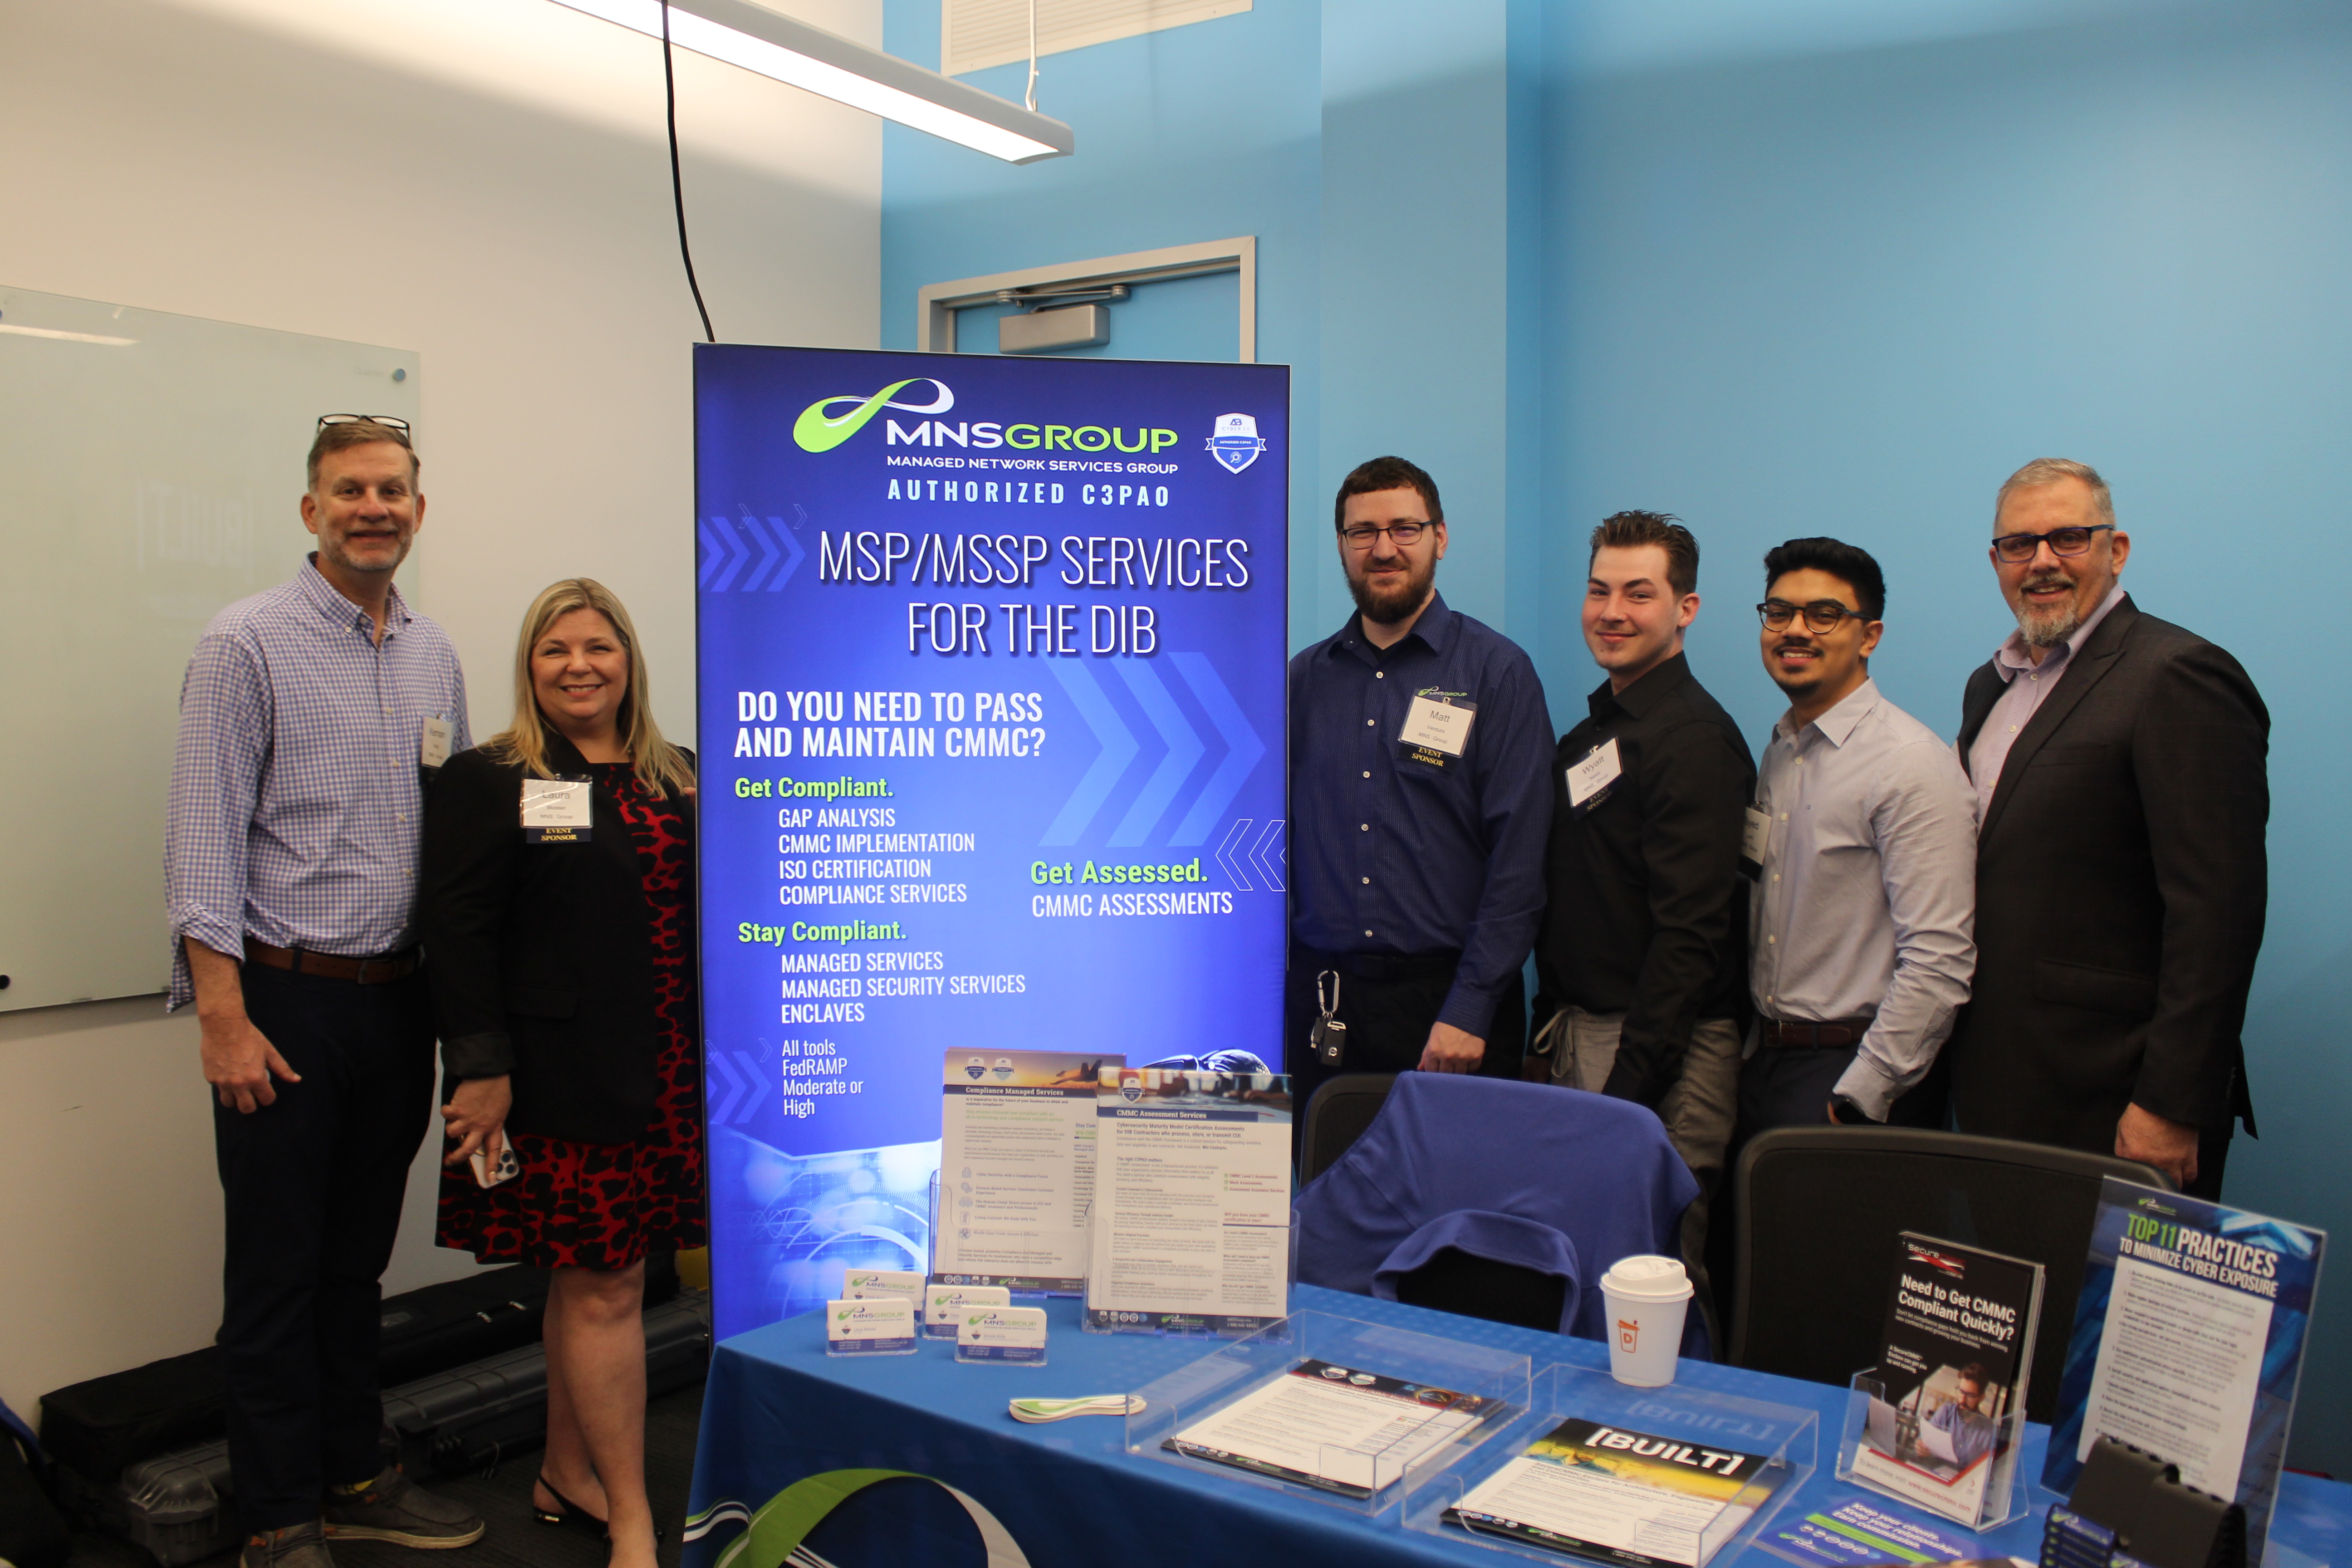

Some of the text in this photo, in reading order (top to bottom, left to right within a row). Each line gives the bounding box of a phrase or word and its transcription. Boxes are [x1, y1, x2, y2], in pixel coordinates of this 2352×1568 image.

[887, 420, 1178, 454] MNSGROUP
[887, 455, 1178, 475] MANAGED NETWORK SERVICES GROUP
[887, 479, 1169, 507] AUTHORIZED C3PAO
[819, 530, 1248, 587] MSP/MSSP SERVICES
[909, 602, 1156, 654] FOR THE DIB
[738, 691, 1043, 722] DO YOU NEED TO PASS
[1430, 710, 1450, 723] Matt
[1427, 725, 1445, 733] Ventura
[734, 727, 1045, 758] AND MAINTAIN CMMC?
[1419, 747, 1443, 758] EVENT
[1411, 753, 1444, 766] SPONSOR
[1582, 756, 1604, 774] Wyatt
[542, 790, 570, 799] Laura
[735, 776, 894, 802] Get Compliant.
[779, 808, 895, 828] GAP ANALYSIS
[779, 833, 975, 853] CMMC IMPLEMENTATION
[779, 859, 931, 879] ISO CERTIFICATION
[1031, 858, 1208, 884] Get Assessed.
[780, 884, 967, 905] COMPLIANCE SERVICES
[1032, 892, 1233, 917] CMMC ASSESSMENTS
[738, 920, 907, 946] Stay Compliant.
[781, 951, 943, 973] MANAGED SERVICES
[781, 975, 1026, 999] MANAGED SECURITY SERVICES
[781, 1003, 865, 1024] ENCLAVES
[782, 1039, 836, 1057] All tools
[783, 1058, 848, 1076] FedRAMP
[783, 1079, 863, 1096] Moderate or
[784, 1098, 815, 1118] High
[2128, 1213, 2278, 1279] TOP 11 PRACTICES
[2120, 1237, 2279, 1298] TO MINIMIZE CYBER EXPOSURE
[1901, 1274, 2016, 1323] Need to Get CMMC
[1898, 1291, 2014, 1341] Compliant Quickly?
[1623, 1333, 1633, 1344] D
[1905, 1319, 1924, 1329] contracts
[1933, 1329, 1950, 1339] growing
[1913, 1315, 1938, 1327] compliance
[1968, 1333, 1979, 1341] back
[1979, 1337, 1990, 1345] from
[1307, 1376, 1346, 1389] Government
[1389, 1395, 1421, 1405] Enclaves
[1585, 1427, 1744, 1475] [BUILT]
[1582, 1474, 1610, 1484] Enclave
[1623, 1483, 1668, 1497] Architecture,
[1866, 1461, 1879, 1471] learn
[1909, 1480, 1971, 1513] www.securecmmc.com
[1832, 1511, 1921, 1549] Earn commission.
[1842, 1508, 1963, 1558] Keep your relationships.
[1852, 1502, 1940, 1541] Keep your clients.
